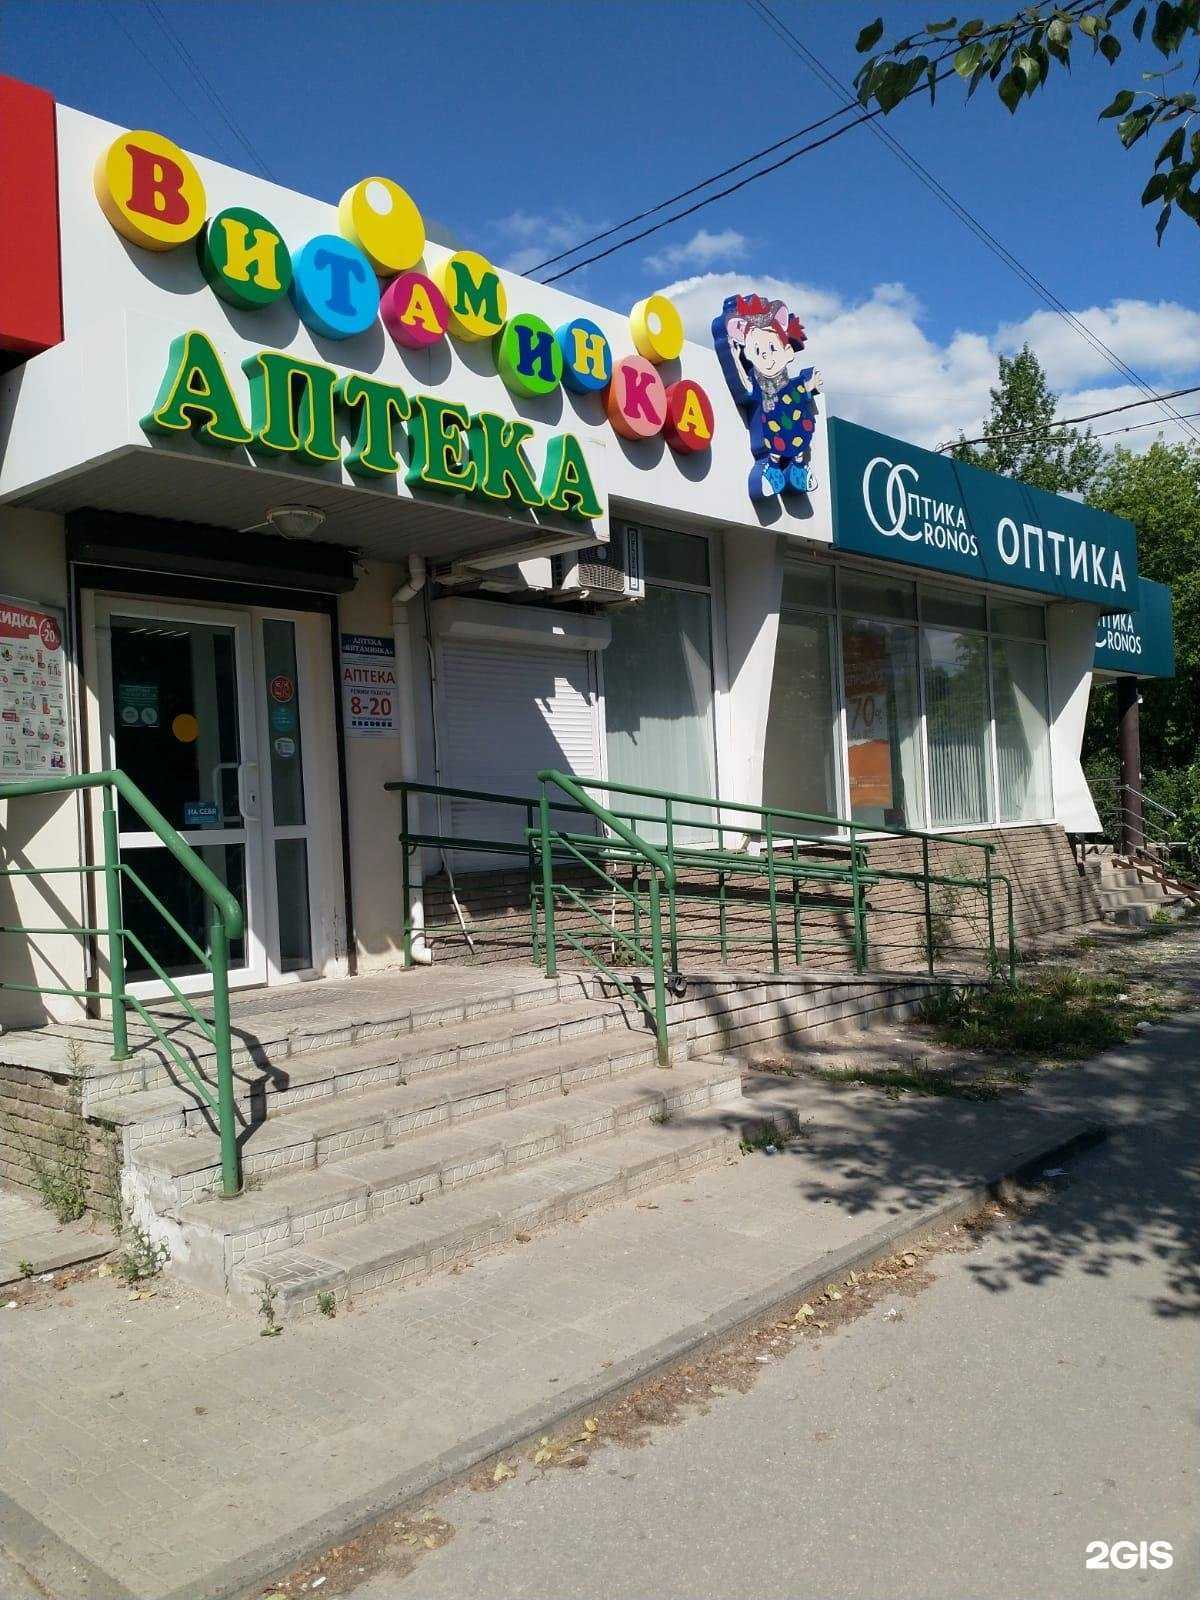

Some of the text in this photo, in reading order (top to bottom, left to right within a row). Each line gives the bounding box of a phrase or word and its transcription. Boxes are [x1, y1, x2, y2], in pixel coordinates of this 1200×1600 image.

[125, 144, 713, 440] ВИТАМИНКА
[148, 331, 604, 519] АПТЕКА
[997, 517, 1127, 592] ОПТИКА
[0, 610, 37, 630] ИДКА
[1095, 630, 1142, 655] RONOS
[344, 667, 396, 685] АПТЕКА
[351, 696, 392, 716] 8-20
